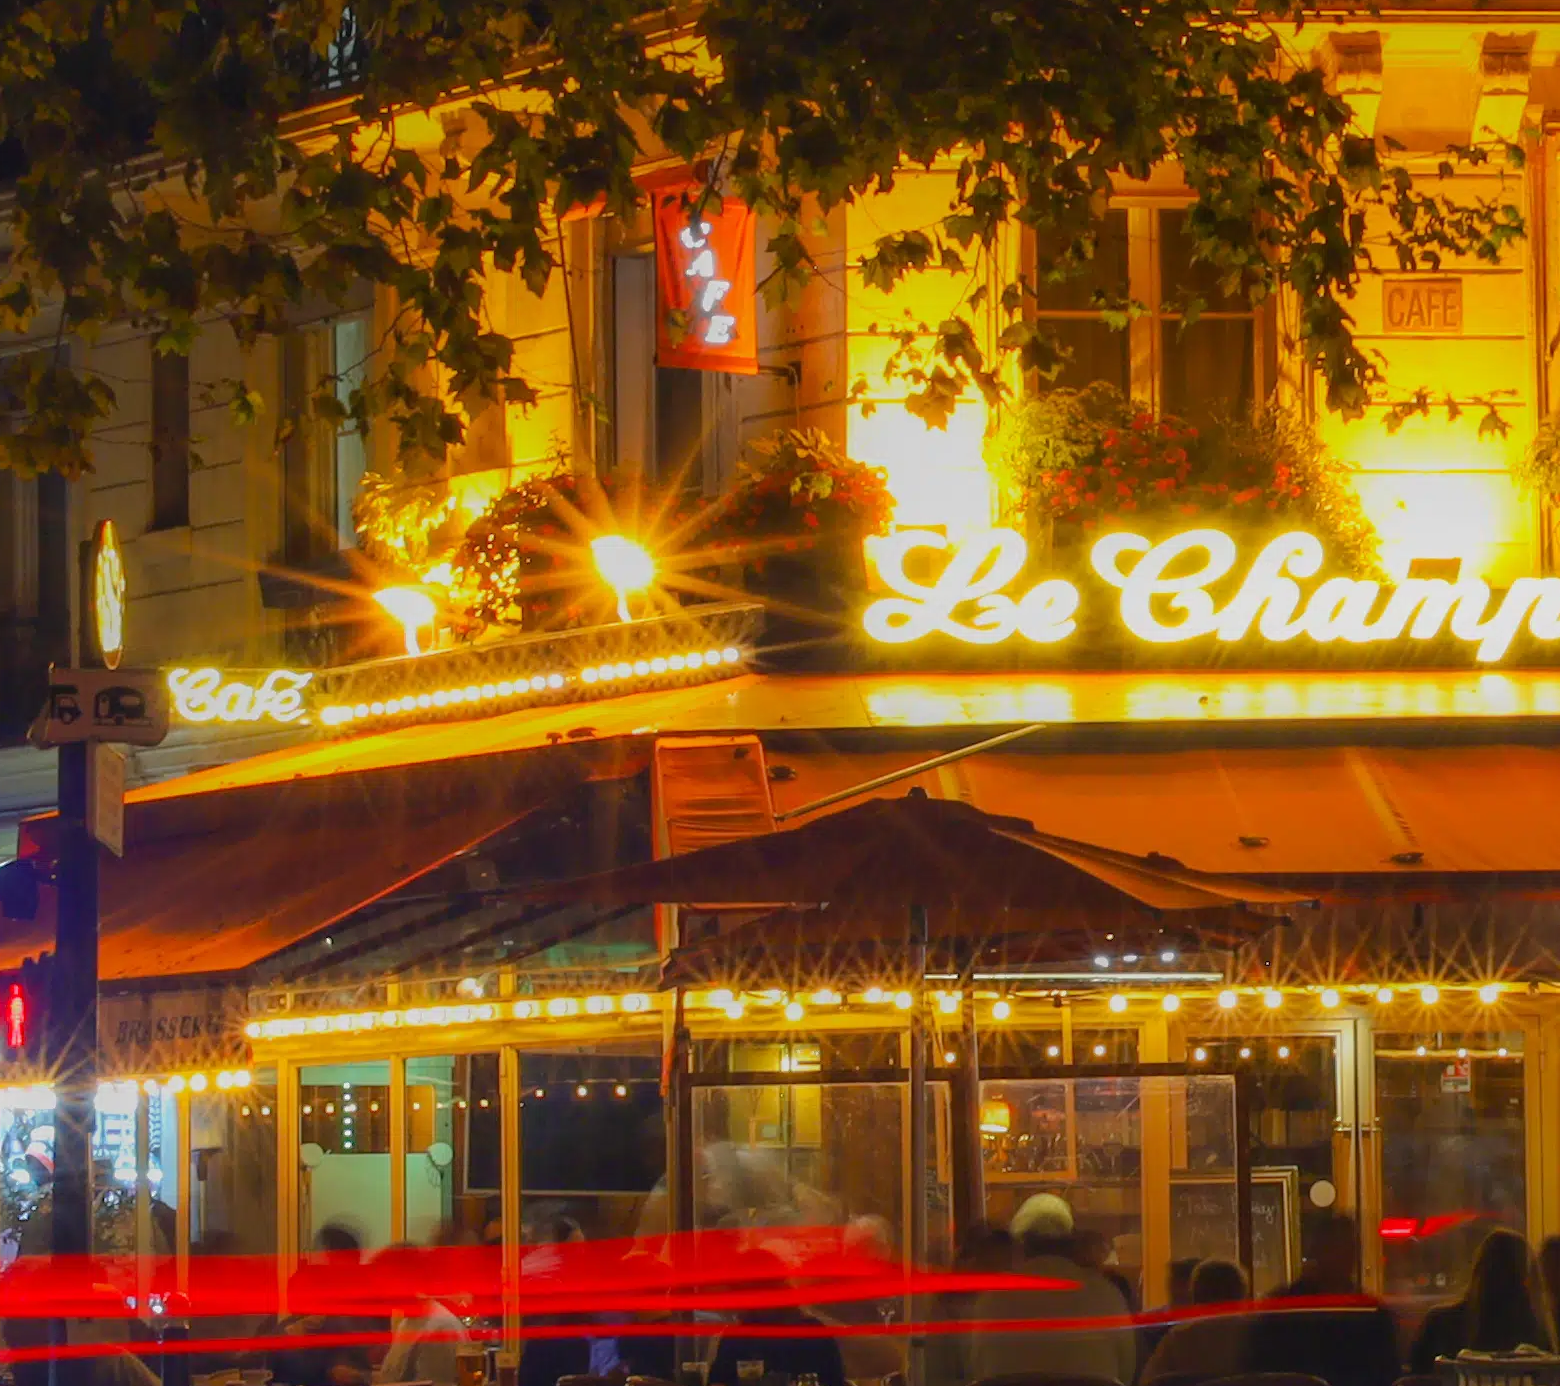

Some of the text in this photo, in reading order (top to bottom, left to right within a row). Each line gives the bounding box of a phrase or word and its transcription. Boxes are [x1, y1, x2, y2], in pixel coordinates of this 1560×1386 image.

[680, 222, 736, 344] CAFE
[1387, 286, 1458, 327] CAFE
[863, 528, 1080, 645] Le
[167, 667, 314, 722] Café
